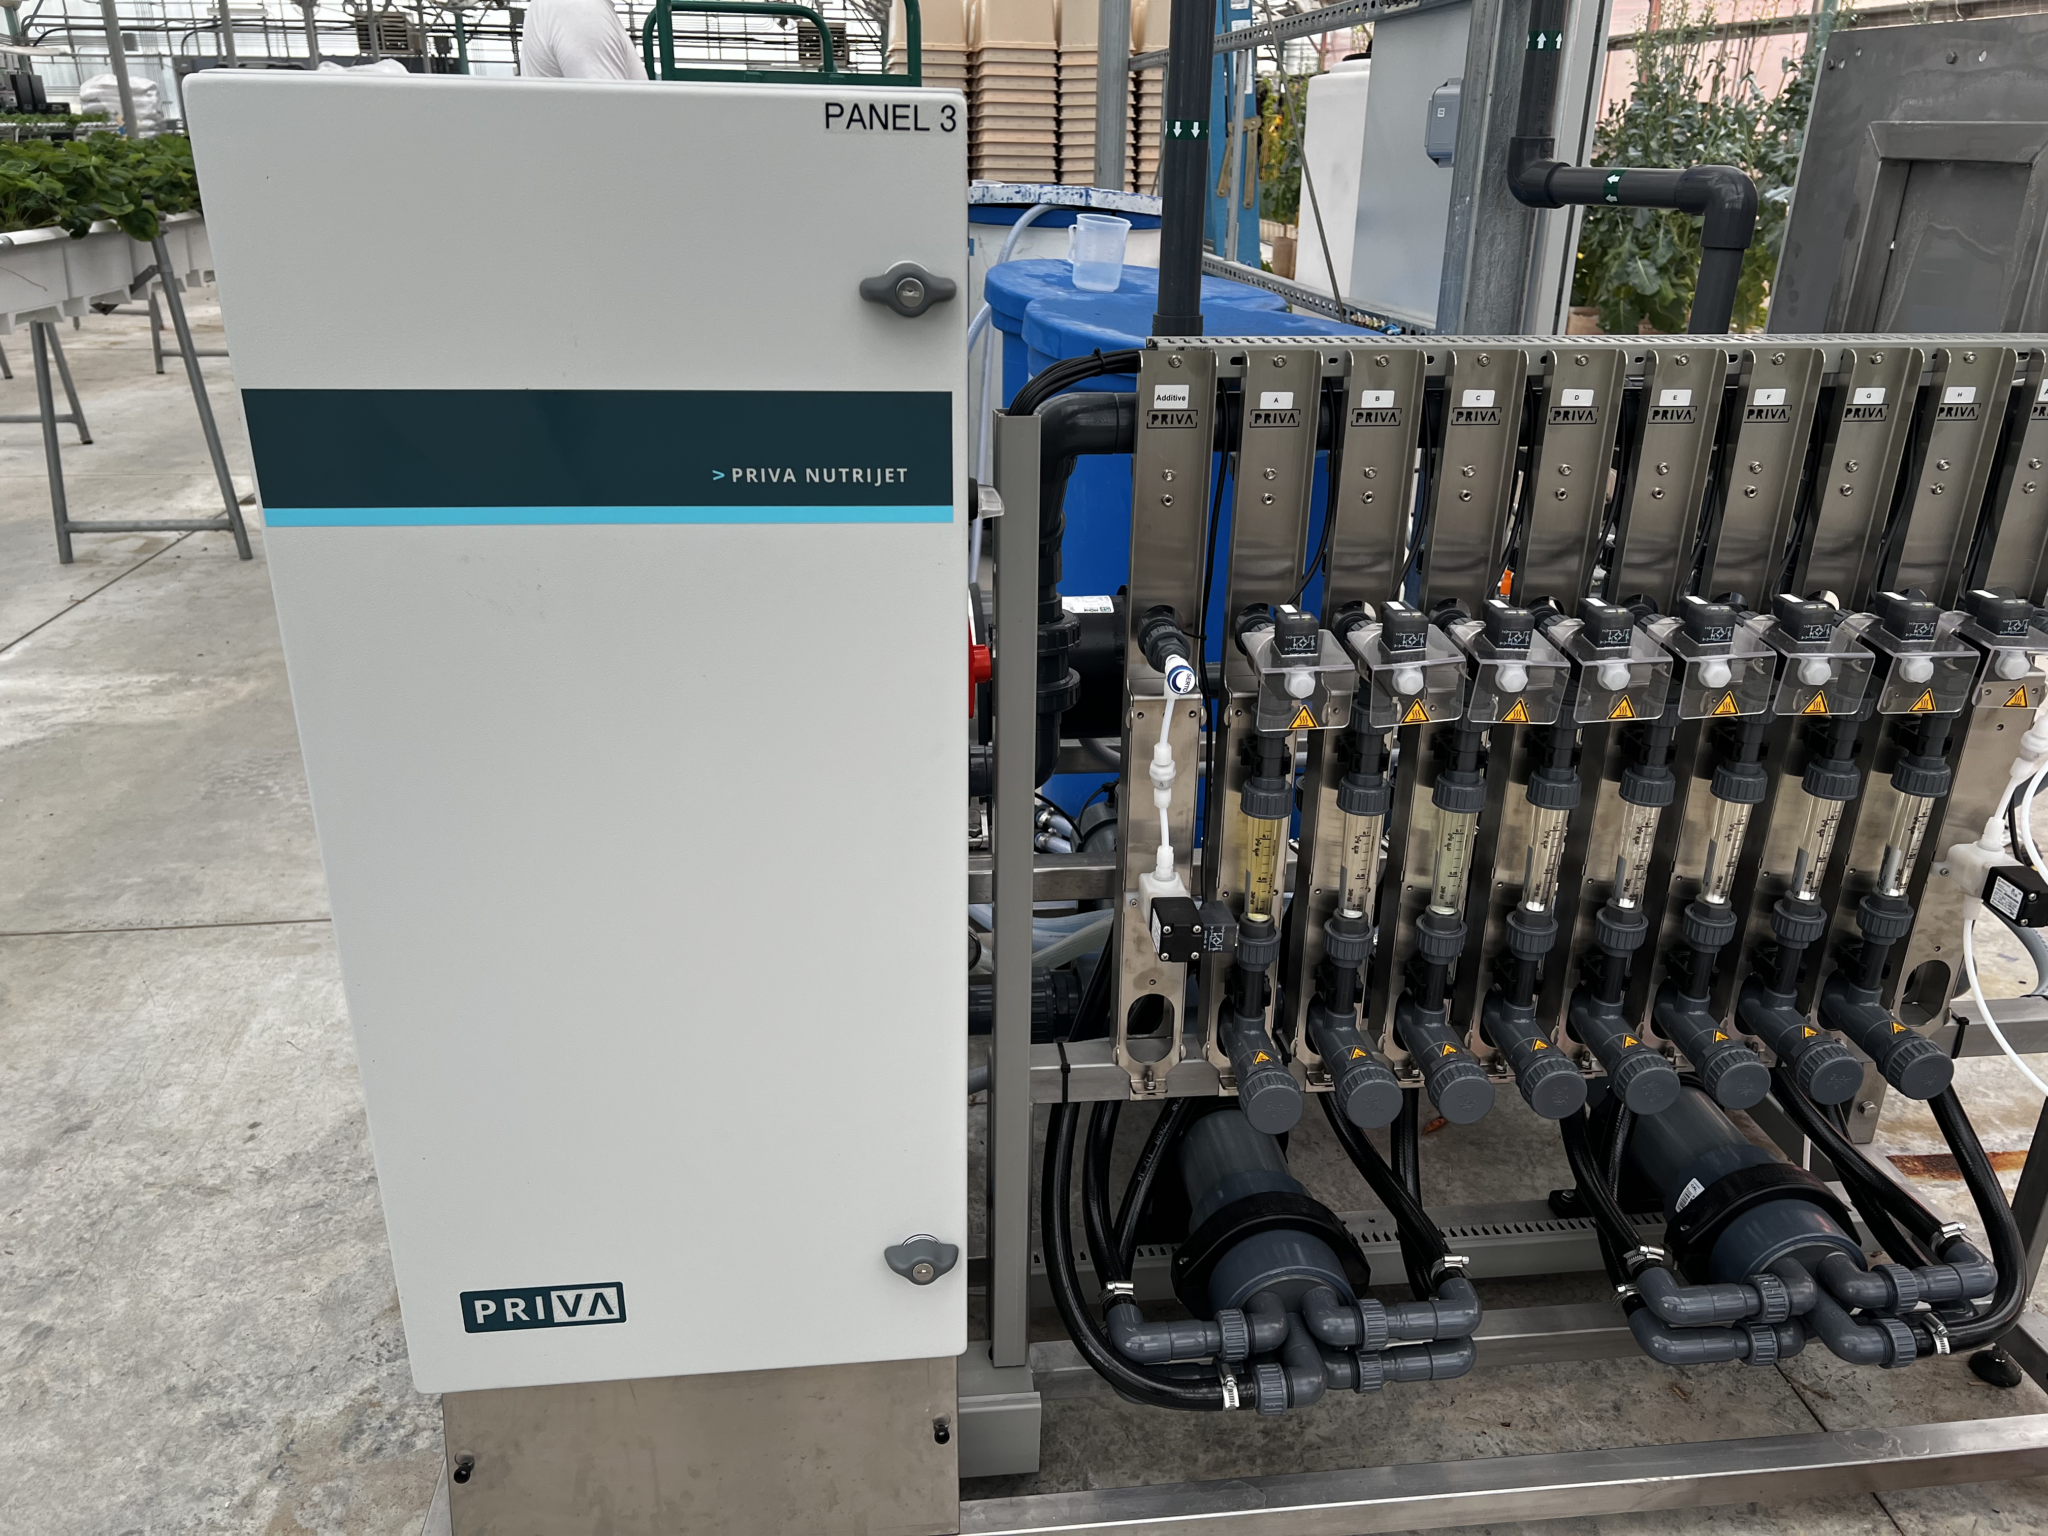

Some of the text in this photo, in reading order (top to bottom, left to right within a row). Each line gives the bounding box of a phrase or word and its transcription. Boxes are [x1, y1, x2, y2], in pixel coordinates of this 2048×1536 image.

[825, 102, 957, 132] PANEL 3
[1155, 394, 1187, 402] Additive
[1254, 412, 1296, 424] PRIVA
[1356, 411, 1397, 423] PRIVA
[1455, 410, 1497, 422] PRIVA
[1553, 409, 1594, 421] PRIVA
[1652, 409, 1692, 420] PRIVA
[1746, 408, 1786, 420] PRIVA
[1844, 407, 1883, 419] PRIVA
[1937, 406, 1976, 418] PRIVA
[1151, 413, 1194, 425] PRIVA
[732, 468, 908, 486] PRIVA NUTRIJET
[1182, 672, 1192, 693] SERTO
[474, 1292, 614, 1324] PRIVA
